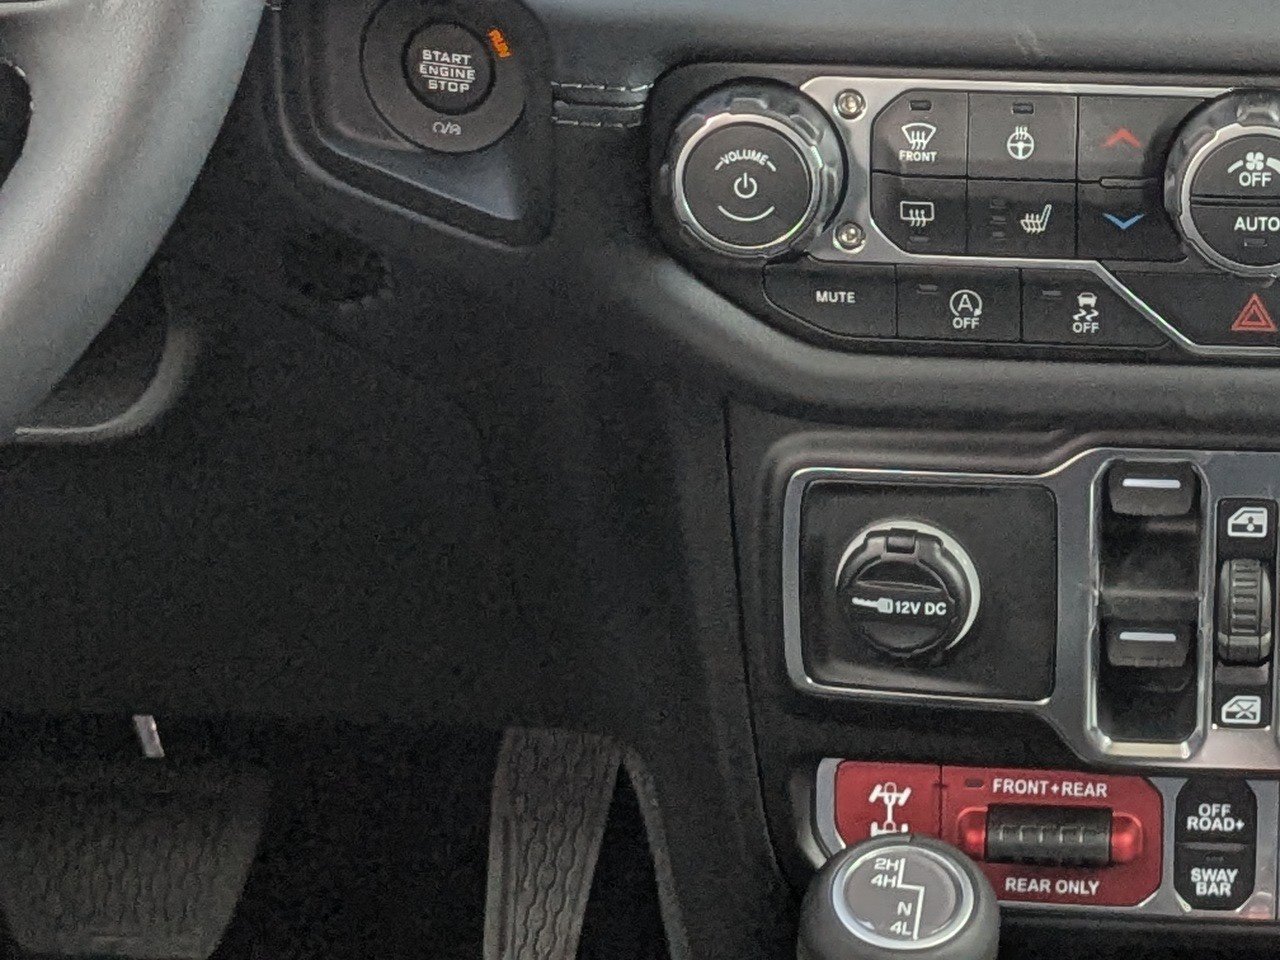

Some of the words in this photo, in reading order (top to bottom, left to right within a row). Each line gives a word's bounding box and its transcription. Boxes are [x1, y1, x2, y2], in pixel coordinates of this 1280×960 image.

[422, 49, 471, 66] START
[419, 64, 476, 81] ENGINE
[427, 79, 470, 93] STOP
[720, 147, 769, 167] VOLUME
[899, 150, 938, 162] FRONT
[1238, 169, 1272, 188] OFF
[1234, 215, 1280, 233] AUTO
[816, 290, 856, 305] MUTE
[952, 315, 980, 330] OFF
[1071, 320, 1099, 334] OFF
[894, 600, 920, 615] 12V
[923, 601, 947, 615] DC
[1199, 803, 1231, 818] OFF
[1187, 815, 1245, 831] ROAD+
[875, 857, 898, 872] 2H
[871, 874, 897, 889] 4H
[1191, 867, 1238, 885] SWAY
[1005, 877, 1051, 895] REAR
[1055, 878, 1100, 896] ONLY
[1195, 881, 1231, 896] BAR
[897, 902, 912, 916] N
[889, 920, 912, 936] 4L
